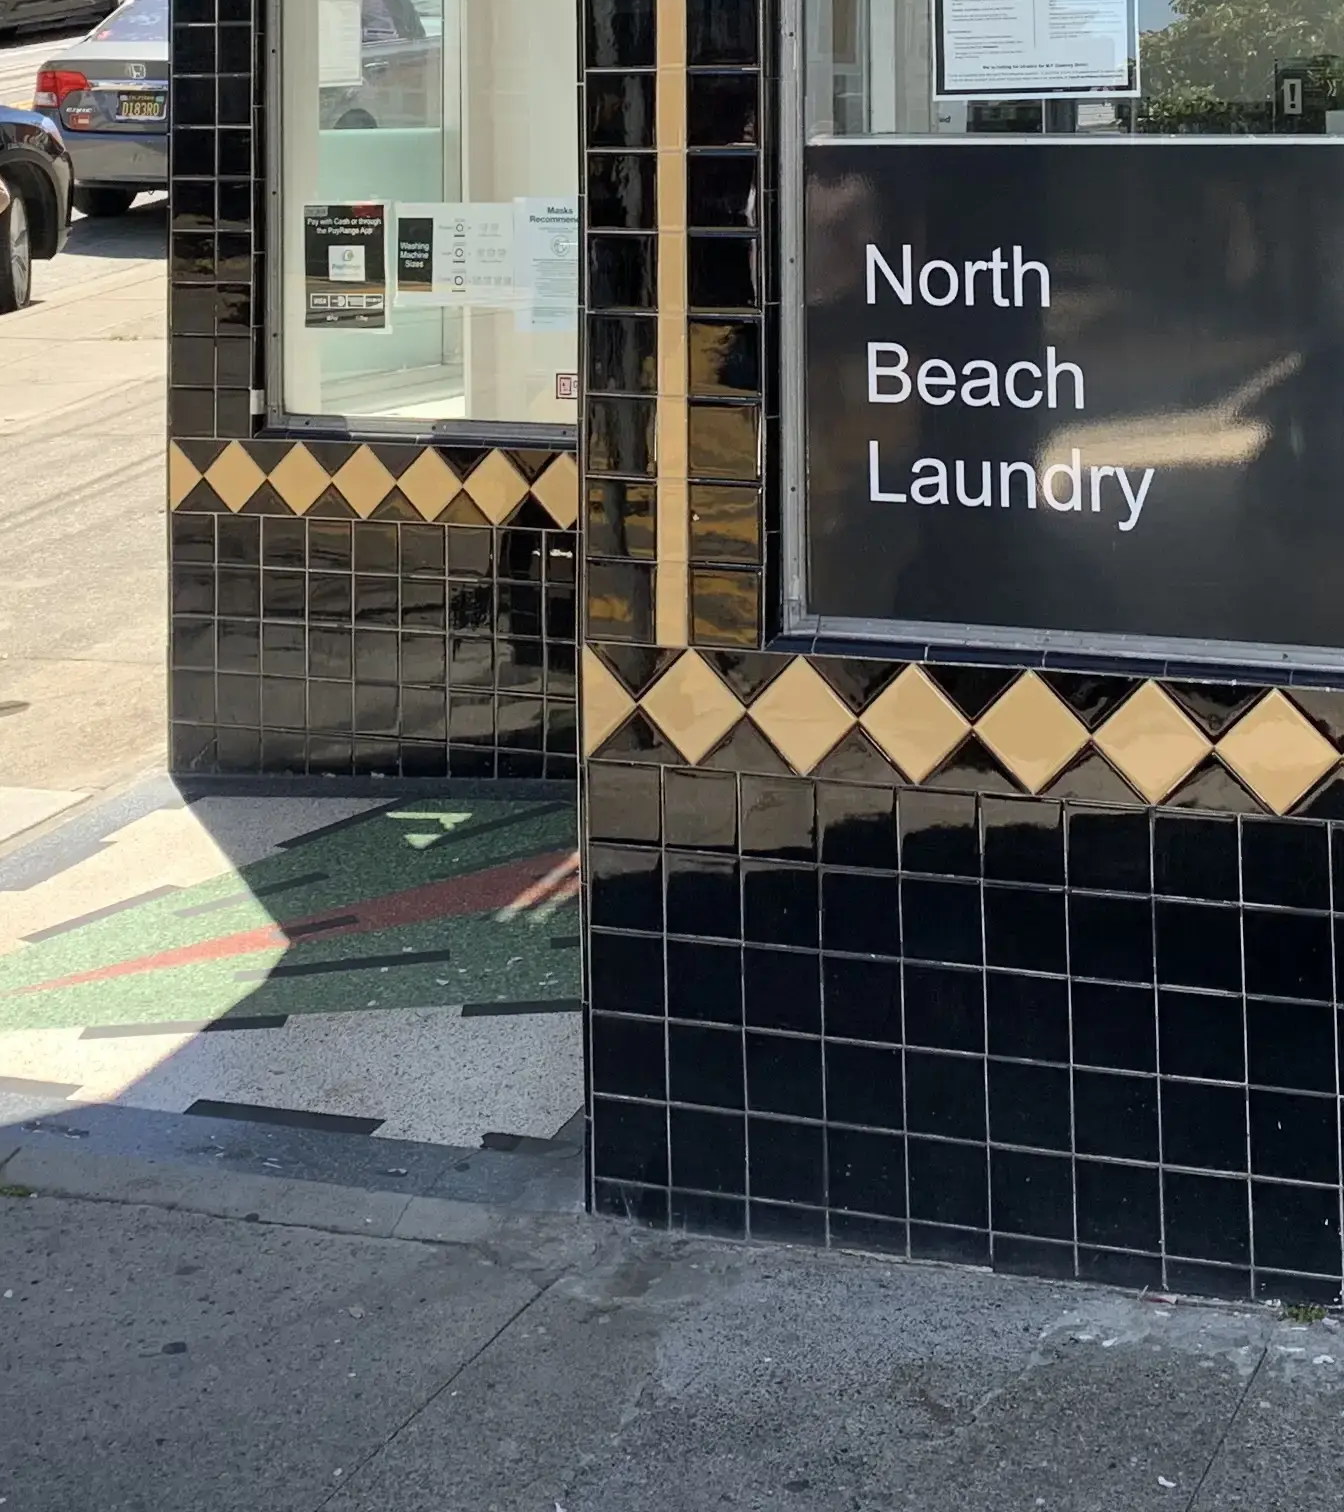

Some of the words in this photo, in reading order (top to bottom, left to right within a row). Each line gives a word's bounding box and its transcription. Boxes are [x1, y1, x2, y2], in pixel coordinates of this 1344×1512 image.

[547, 206, 574, 215] Masks
[865, 243, 1051, 308] North
[866, 341, 1085, 409] Beach
[868, 439, 1155, 532] Laundry
